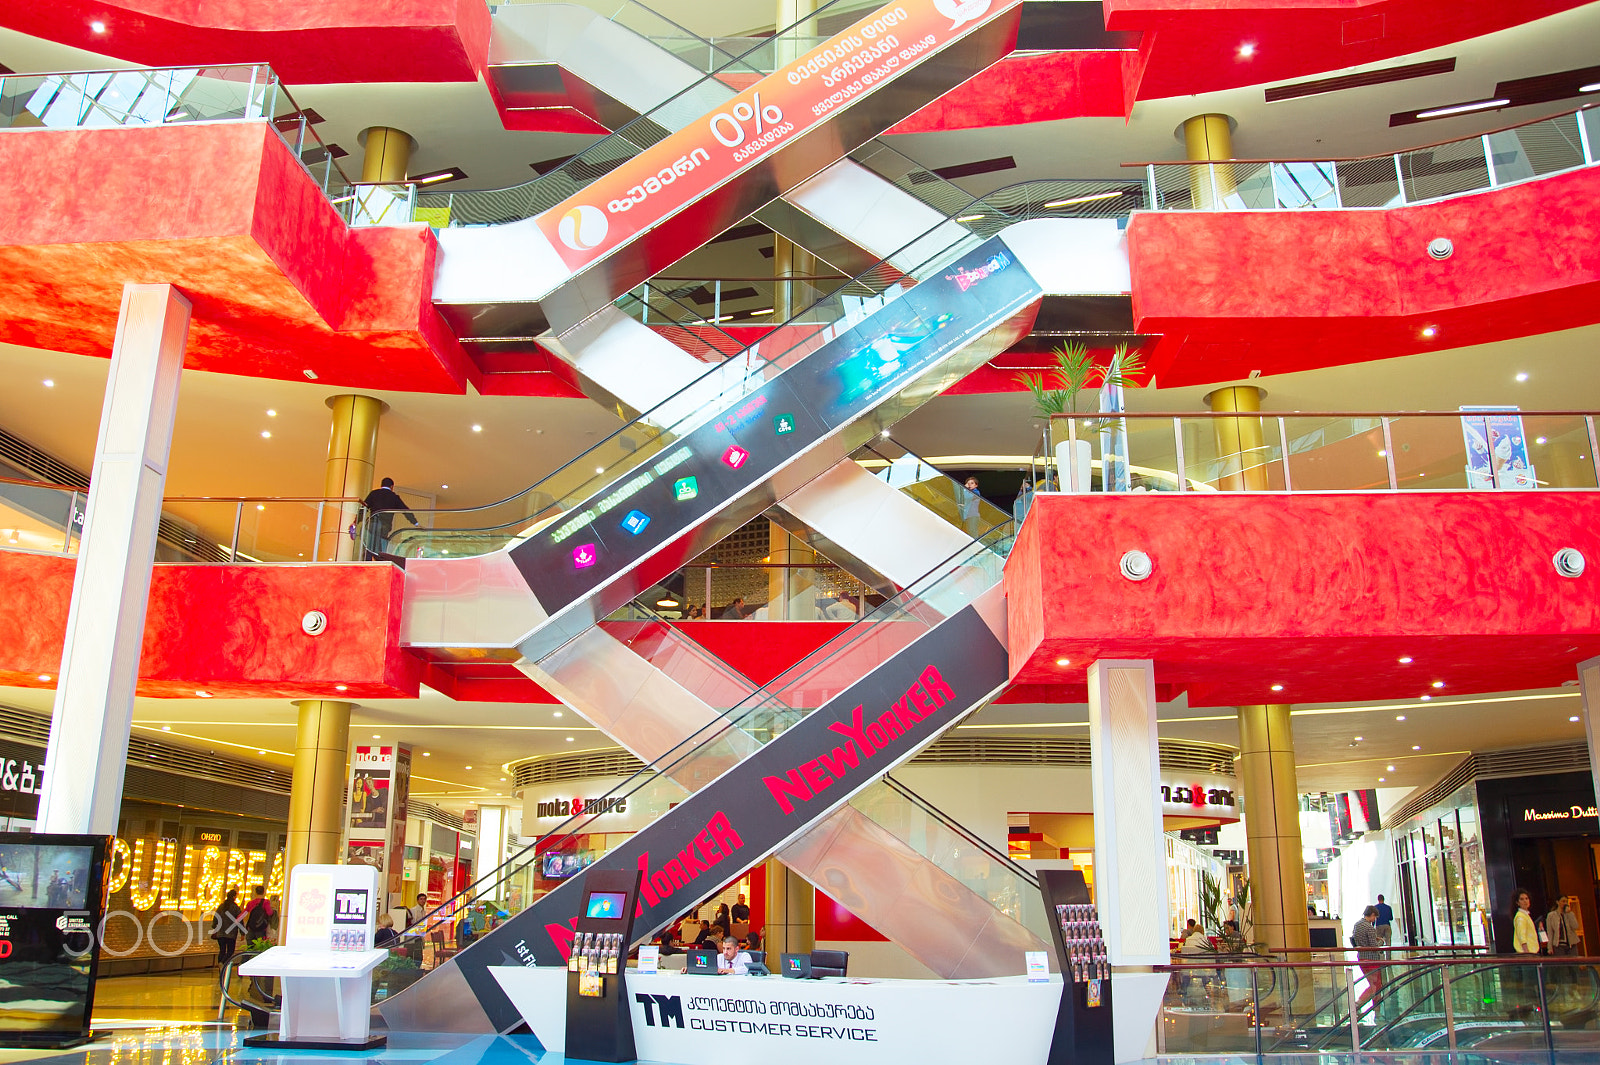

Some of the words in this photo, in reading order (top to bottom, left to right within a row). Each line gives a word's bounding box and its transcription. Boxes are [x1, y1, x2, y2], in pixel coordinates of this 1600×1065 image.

[787, 31, 862, 85] ტექნიკის
[862, 7, 908, 40] დიდი
[821, 34, 900, 87] არჩევანი
[811, 76, 863, 116] ყველაზე
[861, 56, 900, 85] დაბალ
[899, 33, 937, 61] ფასად
[710, 91, 783, 148] 0%
[732, 121, 794, 163] განვადება
[607, 147, 710, 213] ზუმერი
[1524, 808, 1570, 821] Massimo
[1570, 805, 1599, 819] Dutti
[634, 992, 685, 1029] TM
[687, 996, 767, 1014] კლიენტთა
[769, 1001, 875, 1021] მომსახურება
[690, 1018, 792, 1036] CUSTOMER
[795, 1025, 878, 1041] SERVICE
